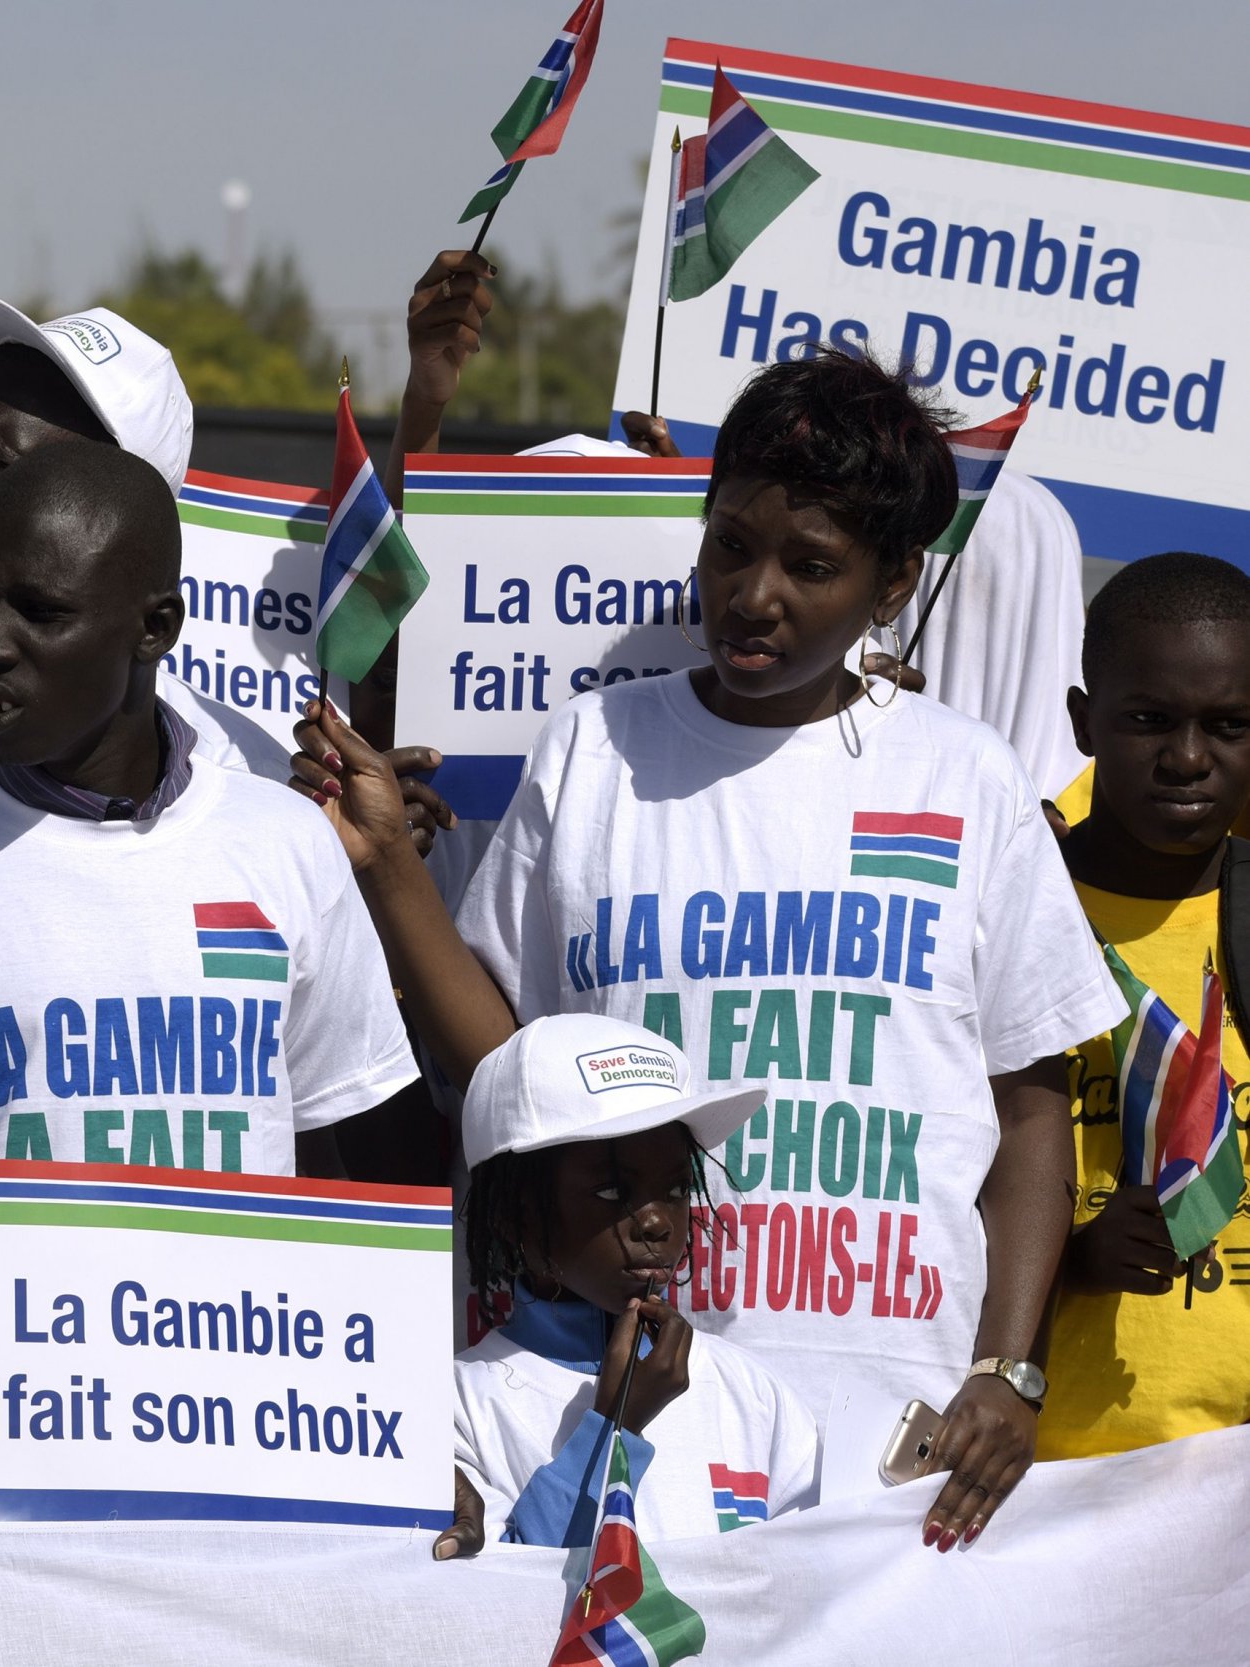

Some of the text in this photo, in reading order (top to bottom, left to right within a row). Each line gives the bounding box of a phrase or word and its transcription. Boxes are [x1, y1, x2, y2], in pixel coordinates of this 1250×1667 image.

[837, 191, 1142, 309] Gambia
[897, 311, 1226, 434] Decided
[464, 564, 530, 624] La
[450, 651, 550, 711] fait
[680, 890, 942, 992] GAMBIE
[43, 996, 283, 1100] GAMBIE
[588, 1055, 626, 1071] Save
[600, 1066, 675, 1084] Democracy
[707, 988, 892, 1086] FAIT
[724, 1098, 923, 1204] CHOIX
[14, 1278, 375, 1363] La Gambie a
[2, 1373, 404, 1459] fait son choix
